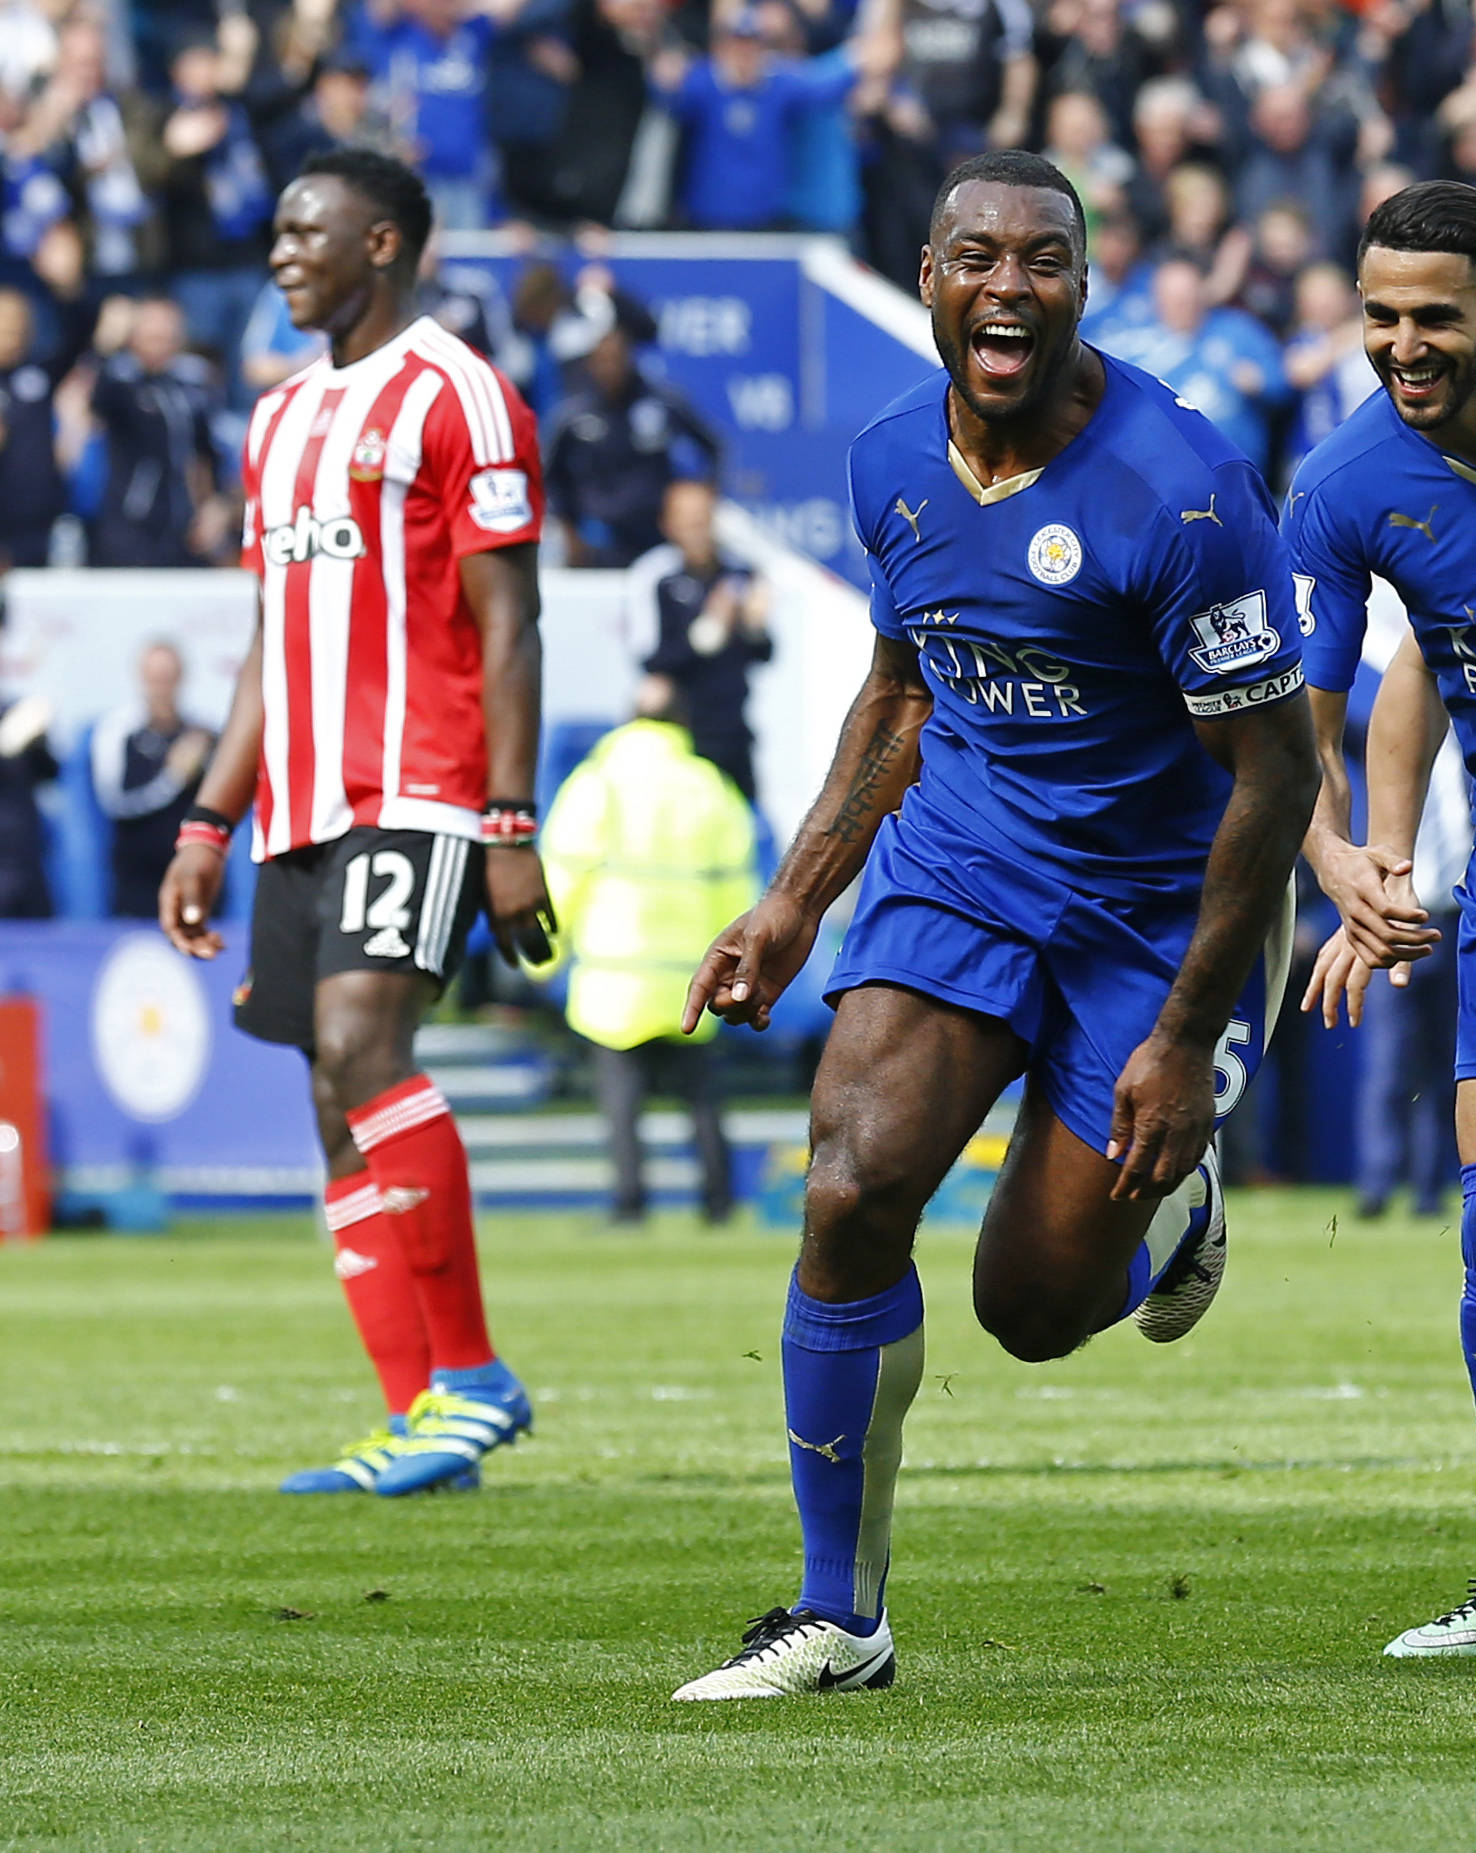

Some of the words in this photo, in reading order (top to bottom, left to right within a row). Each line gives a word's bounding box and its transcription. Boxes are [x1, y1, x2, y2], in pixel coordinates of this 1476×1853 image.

[1208, 638, 1257, 660] BARCLAYS
[943, 674, 1088, 717] OWER
[1246, 667, 1300, 702] CAPT
[339, 850, 415, 934] 12
[1213, 1018, 1251, 1118] 5
